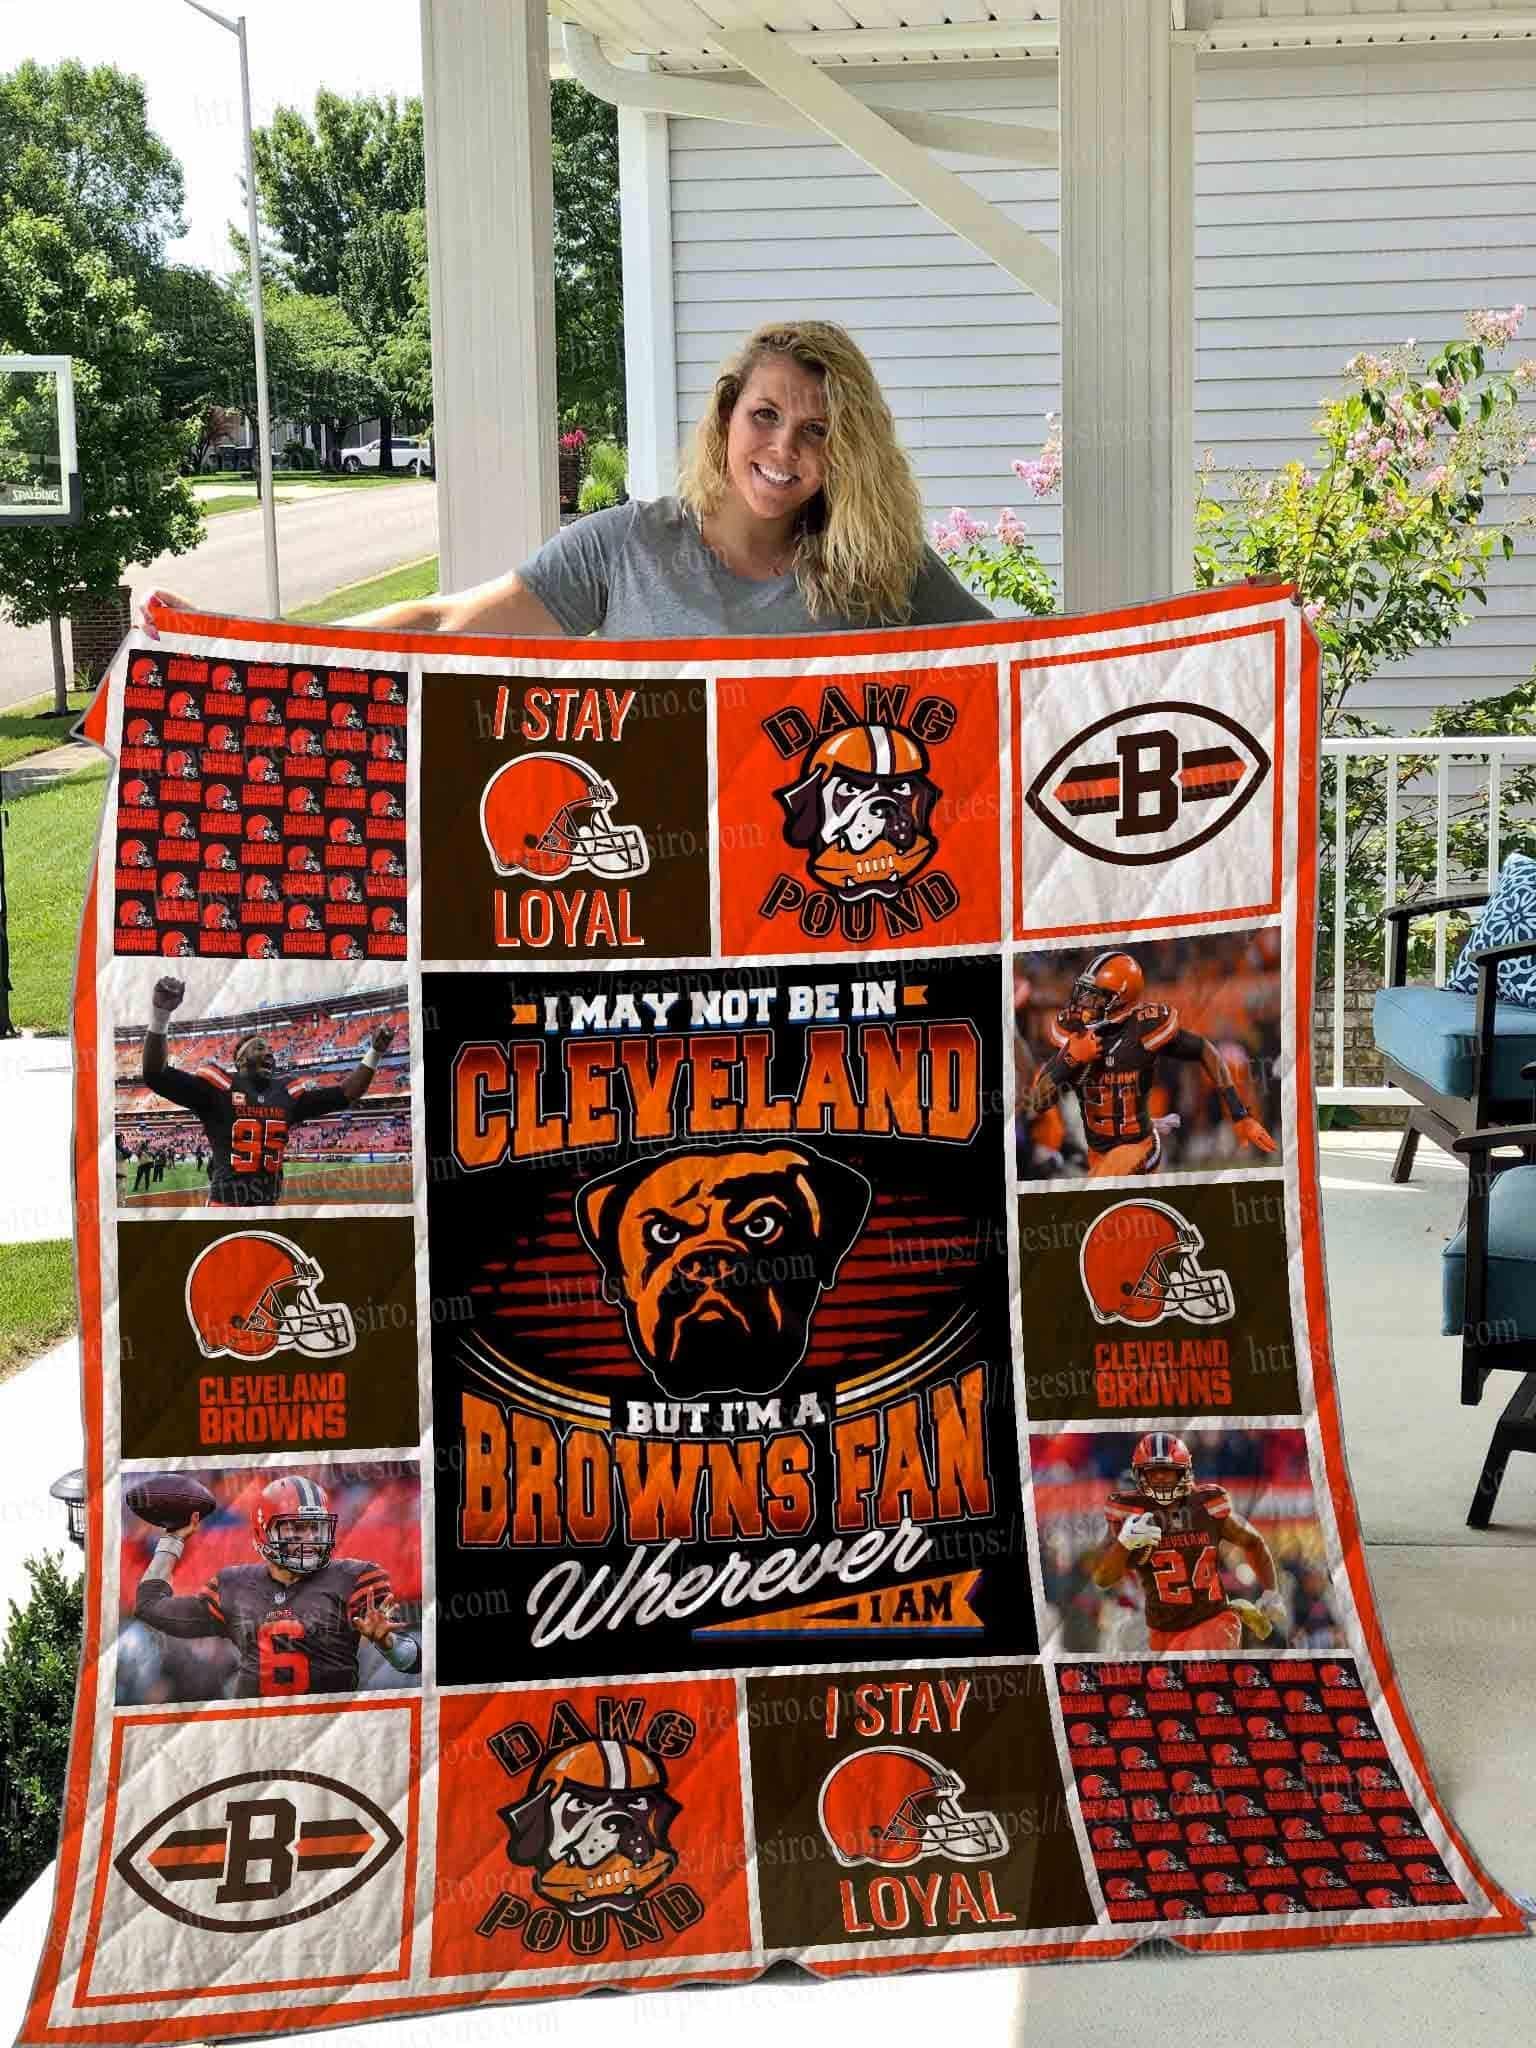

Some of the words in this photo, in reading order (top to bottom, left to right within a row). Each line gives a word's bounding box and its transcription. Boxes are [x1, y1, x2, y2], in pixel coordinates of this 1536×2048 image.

[12, 486, 59, 502] SPALDING
[492, 685, 510, 740] I
[521, 686, 636, 742] STAY
[760, 682, 958, 761] DAWG
[1114, 729, 1179, 838] B
[495, 889, 646, 948] LOYAL
[758, 869, 961, 942] POUND
[543, 996, 562, 1033] I
[569, 992, 680, 1032] MAY
[690, 987, 778, 1026] NOT
[788, 984, 839, 1019] BE
[850, 980, 897, 1016] IN
[452, 1018, 983, 1172] CLEVELAND
[230, 1118, 289, 1174] 95
[1094, 1339, 1229, 1370] CLEVELAND
[199, 1371, 347, 1404] CLEVELAND
[626, 1399, 711, 1434] BUT
[720, 1398, 783, 1432] I'M
[793, 1391, 826, 1426] A
[1096, 1369, 1233, 1408] BROWNS
[199, 1403, 348, 1445] BROWNS
[457, 1390, 816, 1549] BROWNS
[831, 1360, 996, 1530] FAN
[526, 1518, 933, 1648] Wherever
[868, 1594, 884, 1623] I
[892, 1583, 954, 1623] AM
[1152, 1545, 1224, 1604] 24
[256, 1620, 310, 1698] 6
[487, 1696, 696, 1777] DAWG
[825, 1686, 839, 1739] I
[855, 1679, 971, 1737] STAY
[215, 1798, 297, 1904] B
[475, 1883, 705, 1956] POUND
[840, 1870, 1017, 1933] LOYAL
